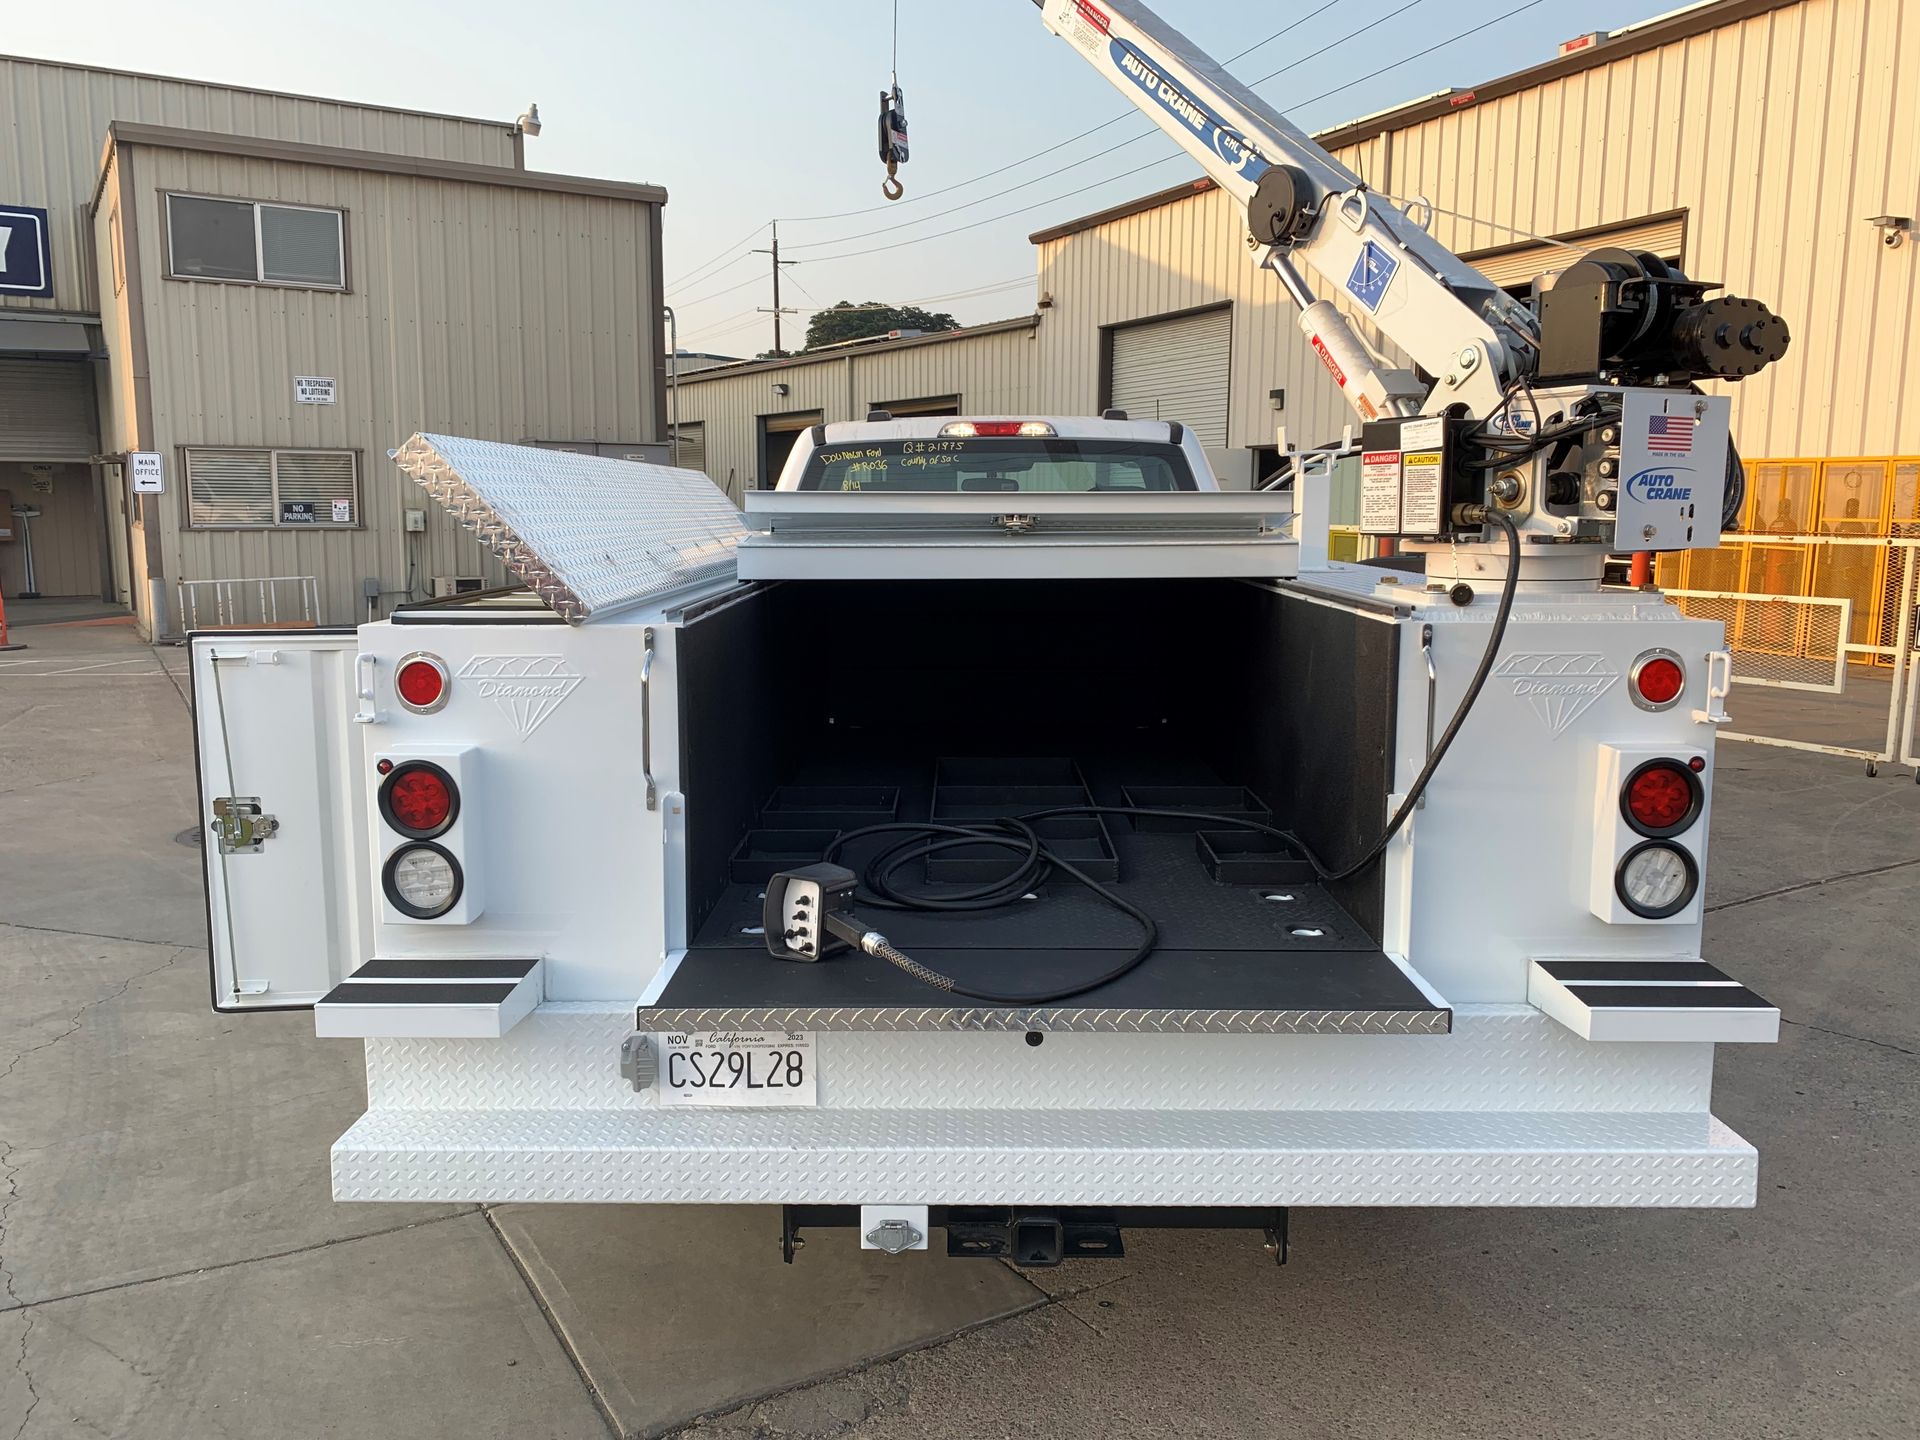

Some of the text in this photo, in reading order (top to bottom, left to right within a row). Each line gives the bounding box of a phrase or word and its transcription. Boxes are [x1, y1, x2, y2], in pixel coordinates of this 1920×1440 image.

[1120, 51, 1209, 131] AUTO CRANE
[1320, 349, 1343, 381] DANGER
[304, 380, 333, 388] TRESPASSING
[309, 388, 330, 396] LOITERING
[1370, 454, 1398, 464] DANGER
[1413, 456, 1439, 464] CAUTION
[1638, 474, 1674, 487] AUTO
[1646, 488, 1692, 500] CRANE
[292, 504, 304, 512] NO
[478, 679, 568, 699] Diamond
[1512, 676, 1604, 697] Diamond
[667, 1035, 688, 1045] NOV
[709, 1032, 766, 1049] California
[668, 1051, 803, 1088] CS29L28
